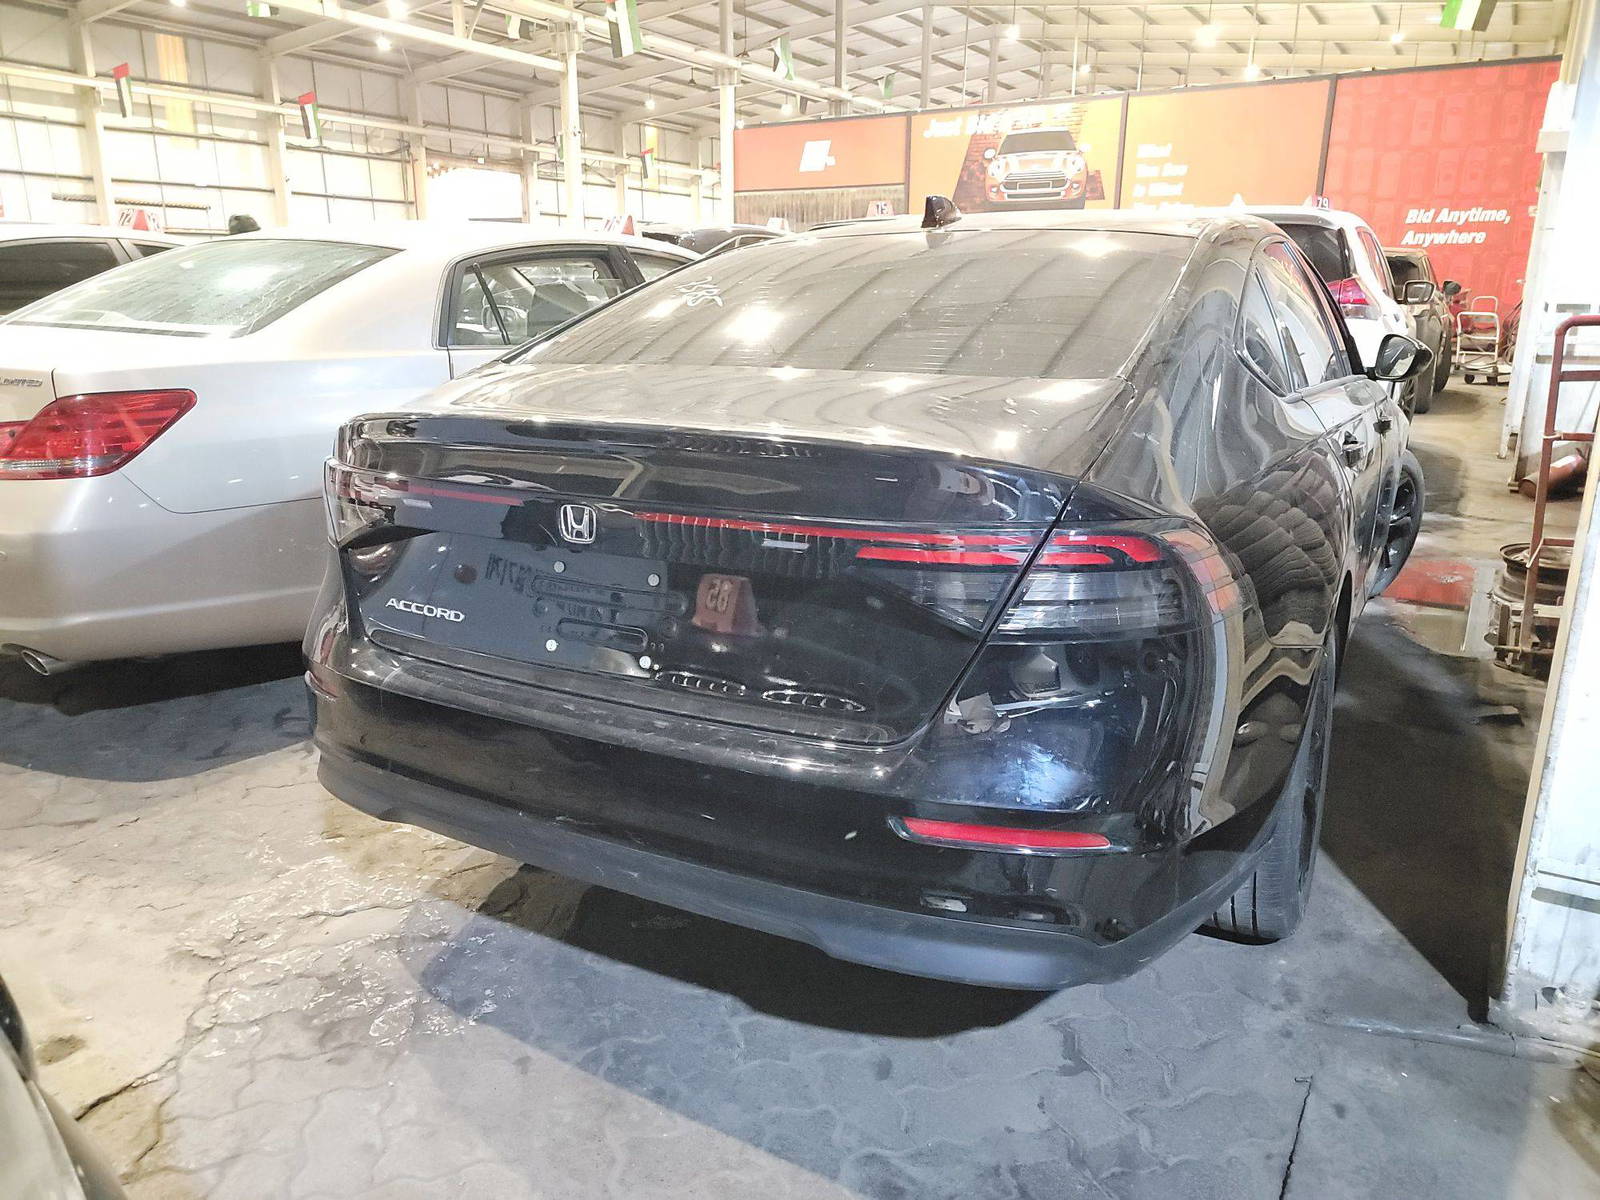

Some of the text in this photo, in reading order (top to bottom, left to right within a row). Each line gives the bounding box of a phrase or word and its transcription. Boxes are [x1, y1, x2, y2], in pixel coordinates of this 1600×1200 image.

[1316, 195, 1329, 209] 79
[1405, 206, 1511, 226] Bid Anytime,
[1400, 229, 1487, 248] Anywhere
[385, 598, 465, 622] ACCORD
